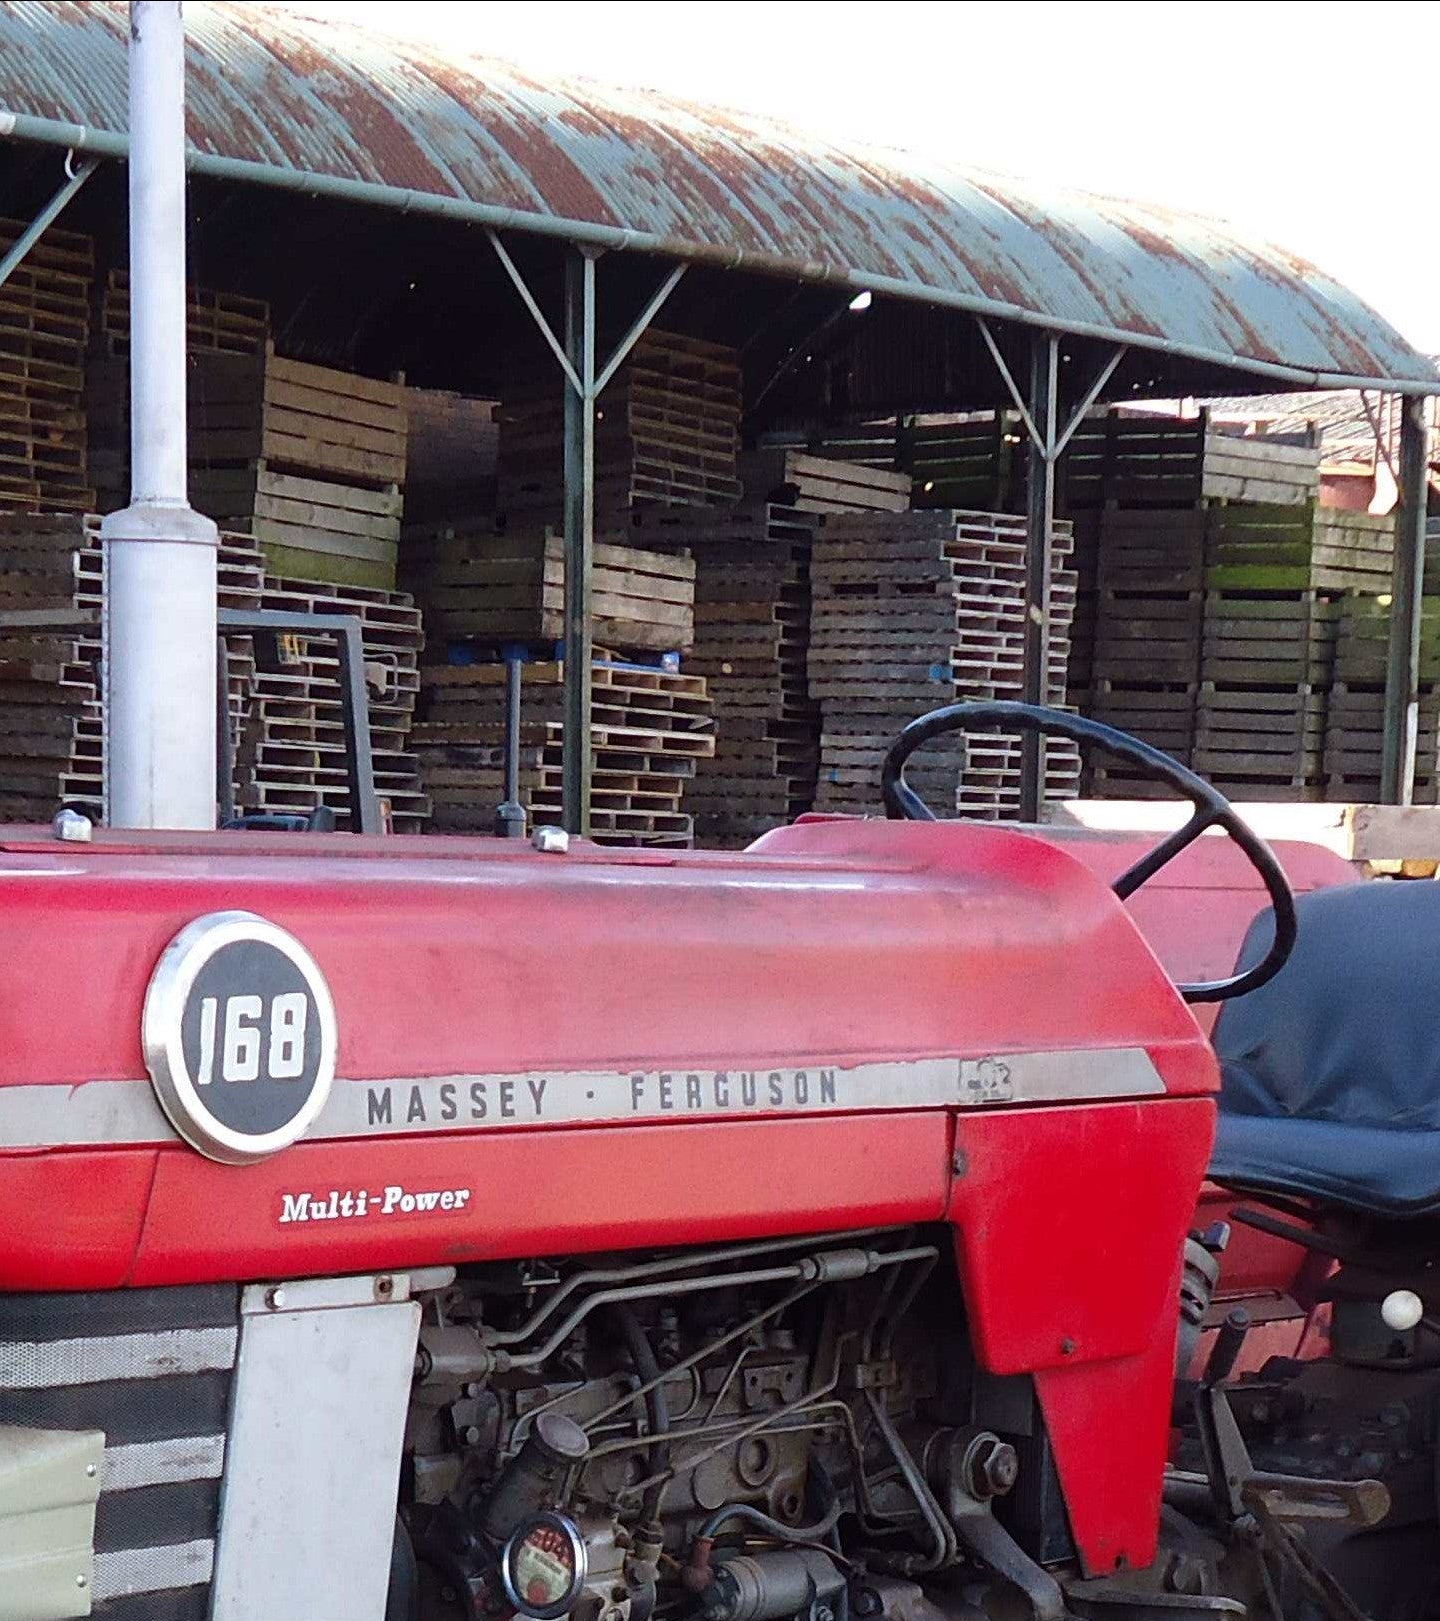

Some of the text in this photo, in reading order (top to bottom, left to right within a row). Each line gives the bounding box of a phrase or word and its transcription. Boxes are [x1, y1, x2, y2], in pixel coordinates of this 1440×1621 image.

[197, 992, 308, 1085] 168
[367, 1069, 837, 1126] MASSEY FERGUSON
[278, 1185, 470, 1223] Multi-Power
